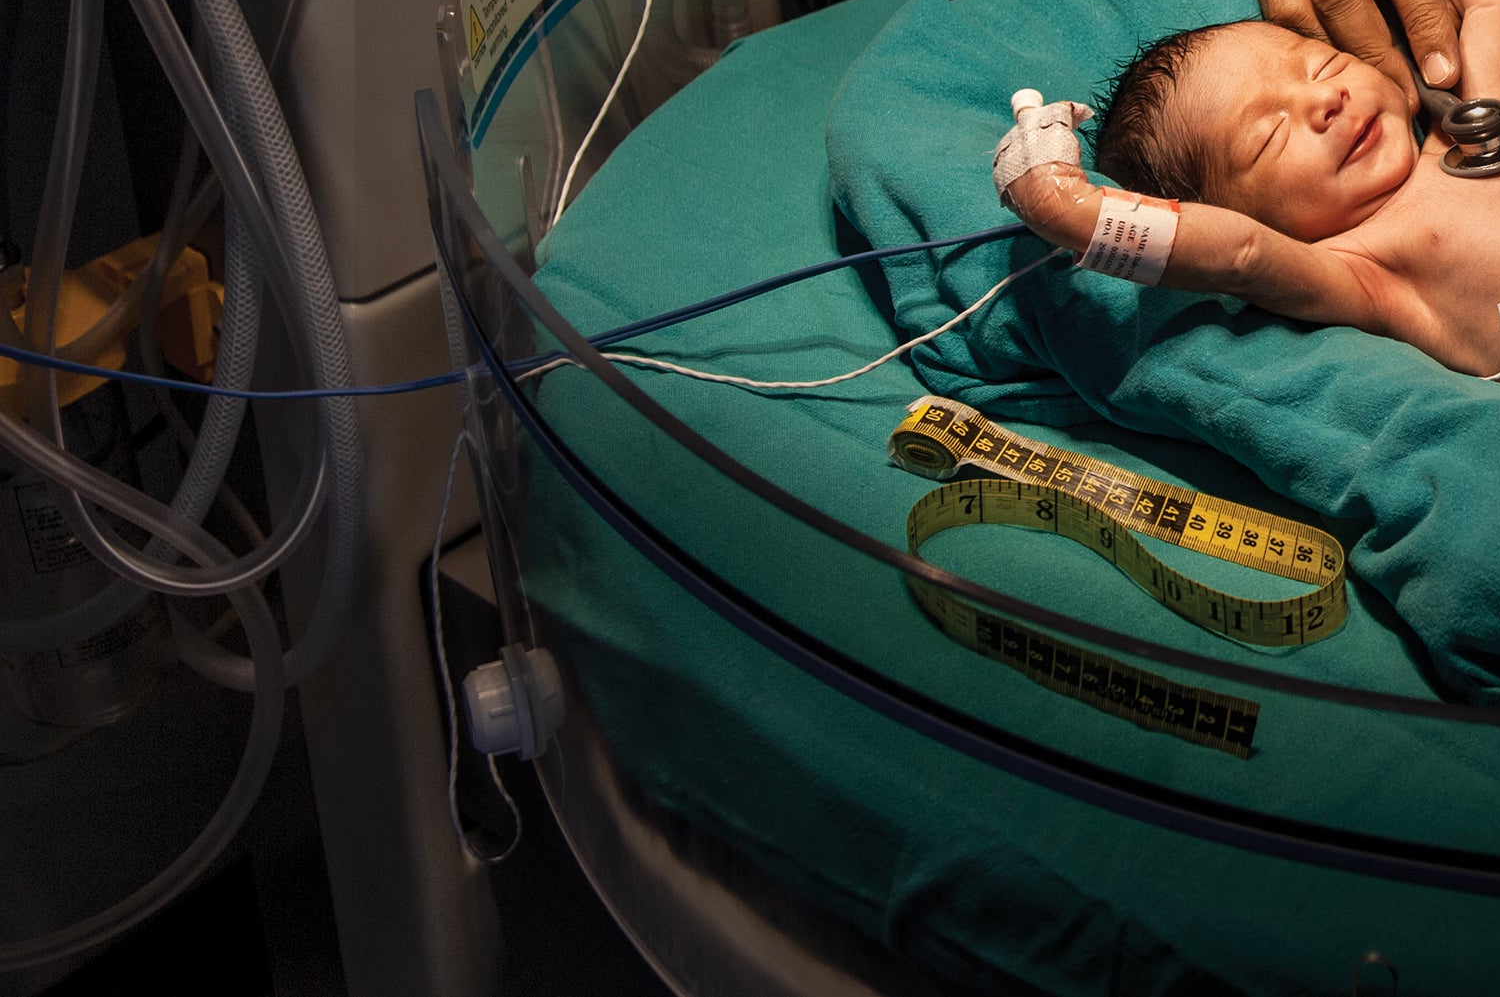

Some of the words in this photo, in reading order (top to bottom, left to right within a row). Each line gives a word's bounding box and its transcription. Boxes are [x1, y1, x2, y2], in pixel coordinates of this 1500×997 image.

[1102, 217, 1114, 236] DOA
[1127, 222, 1137, 242] AGE
[926, 407, 943, 422] 50
[978, 436, 994, 454] 48
[1004, 448, 1020, 464] 47
[1028, 456, 1045, 475] 46
[1056, 466, 1073, 484] 45
[1082, 476, 1098, 495] 44
[1109, 483, 1127, 506] 43
[958, 494, 977, 516] 7
[1035, 500, 1054, 522] 8
[1140, 497, 1156, 516] 42
[1164, 506, 1181, 523] 41
[1188, 512, 1205, 532] 40
[1216, 521, 1234, 540] 39
[1099, 528, 1114, 550] 9
[1242, 529, 1260, 548] 38
[1268, 538, 1285, 556] 37
[1296, 546, 1314, 564] 36
[1322, 553, 1336, 572] 35
[1152, 568, 1182, 602] 10
[1209, 602, 1247, 631] 11
[1281, 605, 1325, 637] 12
[1004, 638, 1018, 650] 9
[1030, 649, 1044, 662] 8
[1054, 662, 1070, 674] 7
[1083, 672, 1099, 684] 6
[1140, 696, 1155, 706] 4
[1168, 704, 1184, 716] 3
[1200, 714, 1216, 725] 2
[1229, 724, 1246, 734] 1
